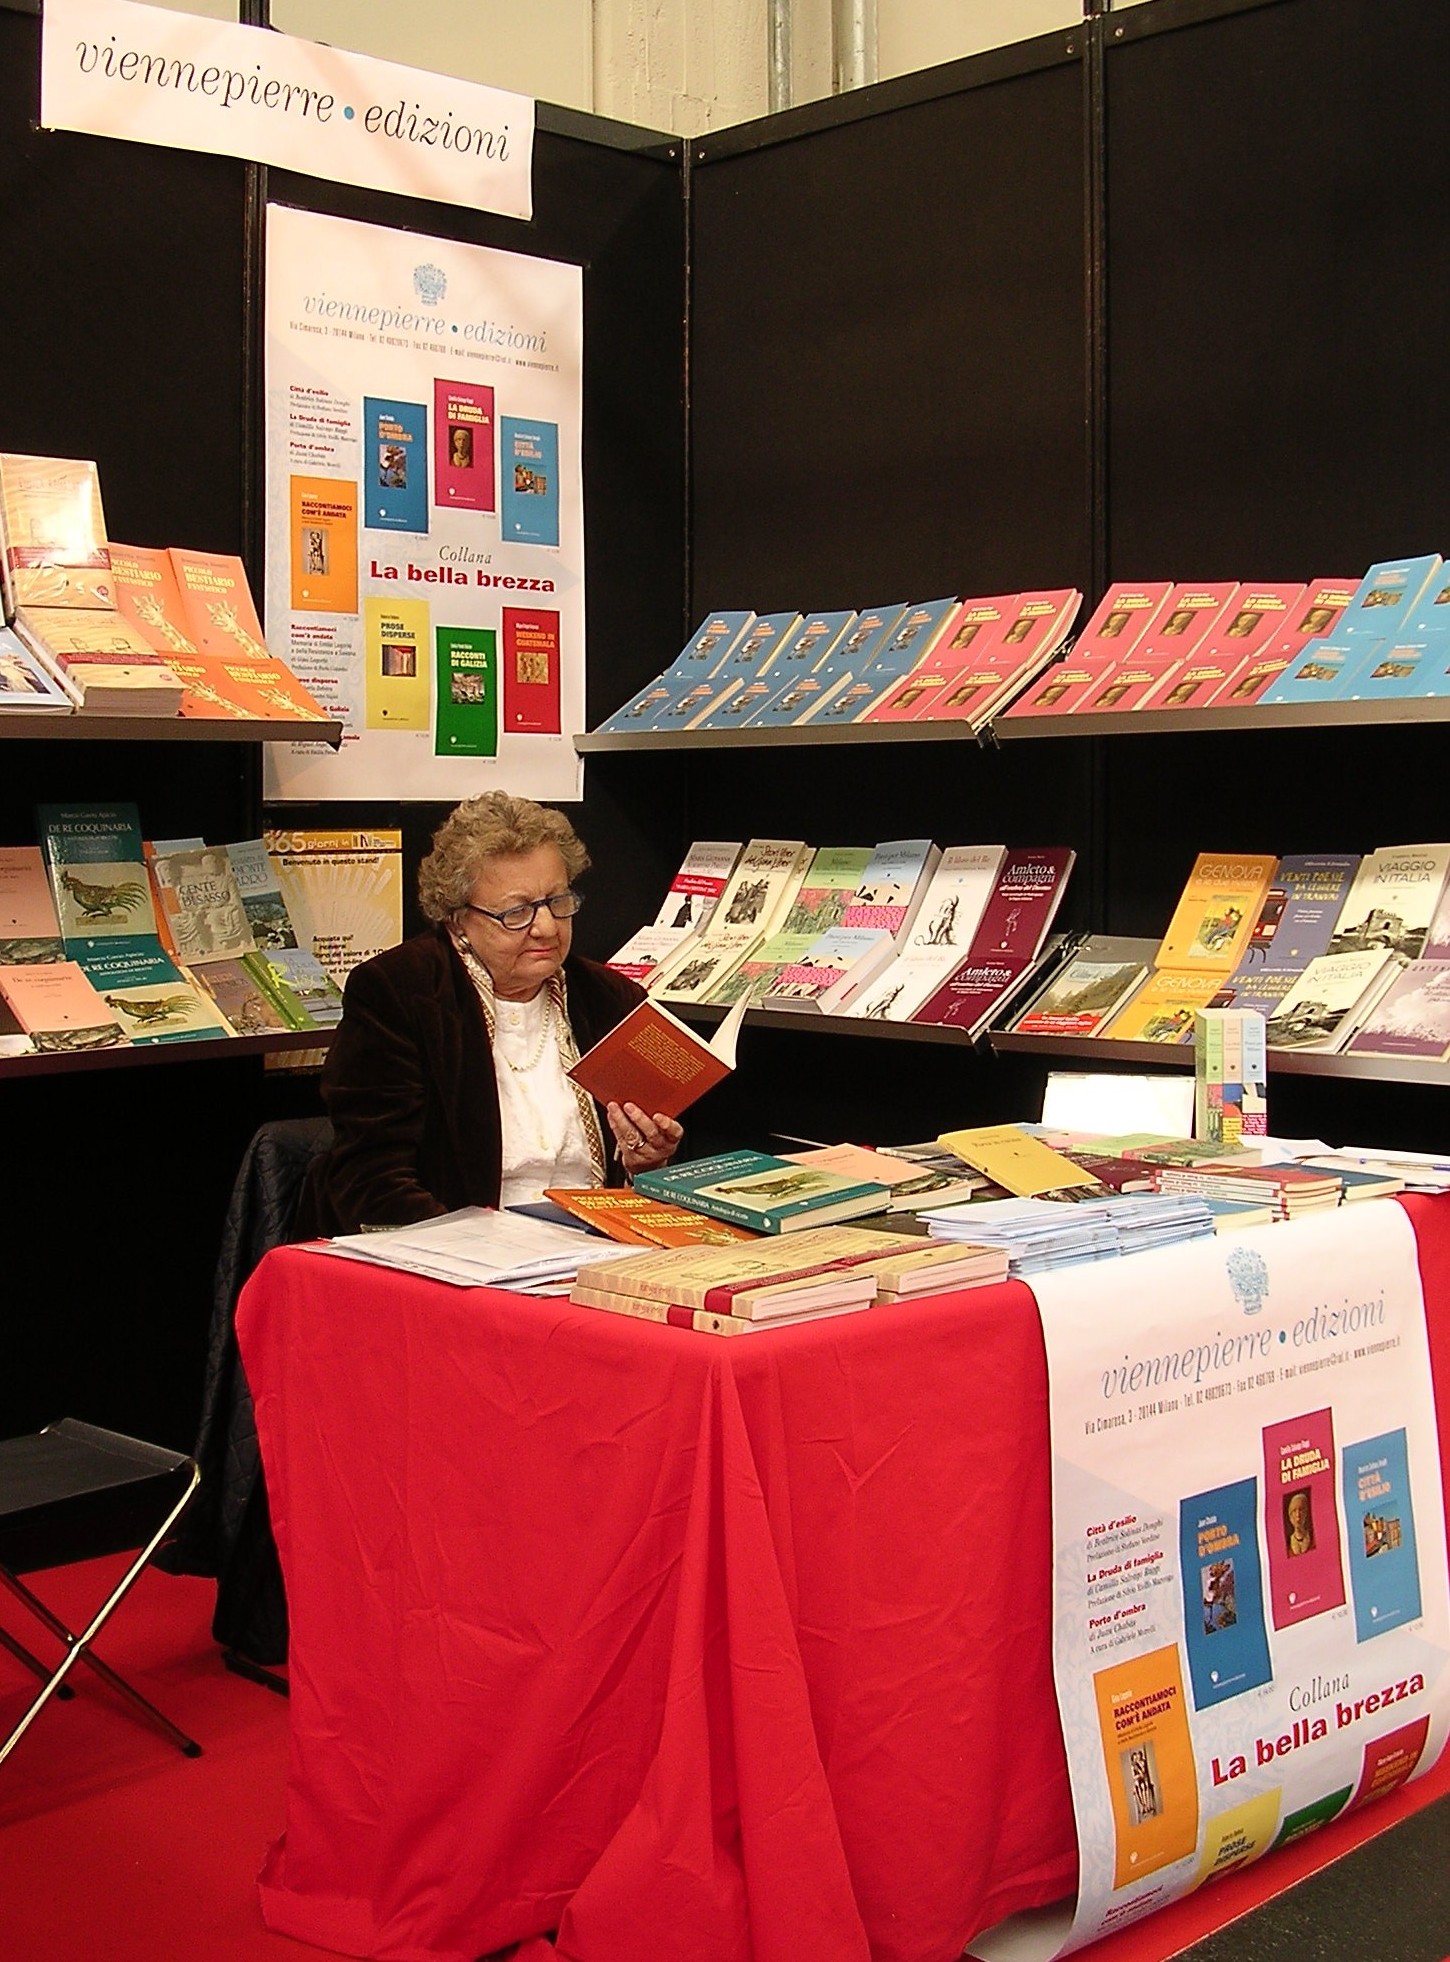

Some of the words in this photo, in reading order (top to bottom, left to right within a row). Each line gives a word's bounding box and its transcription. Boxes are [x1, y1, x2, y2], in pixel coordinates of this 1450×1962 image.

[76, 36, 334, 124] viennepierre
[364, 102, 511, 162] edizioni
[304, 293, 445, 335] viennepierre
[464, 321, 547, 353] edizioni
[439, 545, 492, 564] Collana
[370, 561, 399, 580] La
[408, 564, 468, 586] bella
[478, 566, 555, 592] brezza
[381, 622, 404, 631] PROSE
[381, 630, 416, 640] DISPERSE
[451, 651, 486, 660] RACCONTI
[451, 660, 459, 668] DI
[460, 660, 488, 669] GALIZIA
[49, 824, 62, 834] DE
[62, 824, 74, 833] RE
[75, 823, 133, 834] COQUINARIA
[308, 838, 339, 850] giorni
[1200, 864, 1264, 879] GENOVA
[1378, 860, 1436, 872] VIAGGIO
[1002, 874, 1056, 886] compagni
[1388, 872, 1431, 883] ITALIA
[179, 881, 217, 896] GENTE
[104, 956, 164, 972] COQUINARIA
[1156, 976, 1222, 989] GENOVA
[1102, 1327, 1272, 1399] viennepierre
[1293, 1290, 1386, 1348] edizioni
[1085, 1421, 1095, 1435] Via
[1097, 1414, 1126, 1432] Cimarosa,
[1158, 1400, 1178, 1414] Milano
[1281, 1458, 1292, 1470] LA
[1293, 1448, 1322, 1466] DRUDA
[1282, 1471, 1292, 1484] DI
[1292, 1458, 1330, 1480] FAMIGLIA
[1086, 1522, 1106, 1538] Città
[1108, 1514, 1137, 1531] d'esilio
[1087, 1573, 1096, 1583] La
[1099, 1564, 1122, 1580] Druda
[1124, 1560, 1132, 1570] di
[1134, 1551, 1164, 1568] famiglia
[1088, 1616, 1112, 1630] Porto
[1114, 1604, 1146, 1621] d'ombra
[1114, 1686, 1176, 1718] RACCONTIAMOCI
[1289, 1673, 1350, 1712] Collana
[1116, 1711, 1140, 1730] COM'È
[1142, 1701, 1171, 1720] ANDATA
[1211, 1753, 1246, 1787] La
[1255, 1714, 1328, 1767] bella
[1336, 1672, 1426, 1728] brezza
